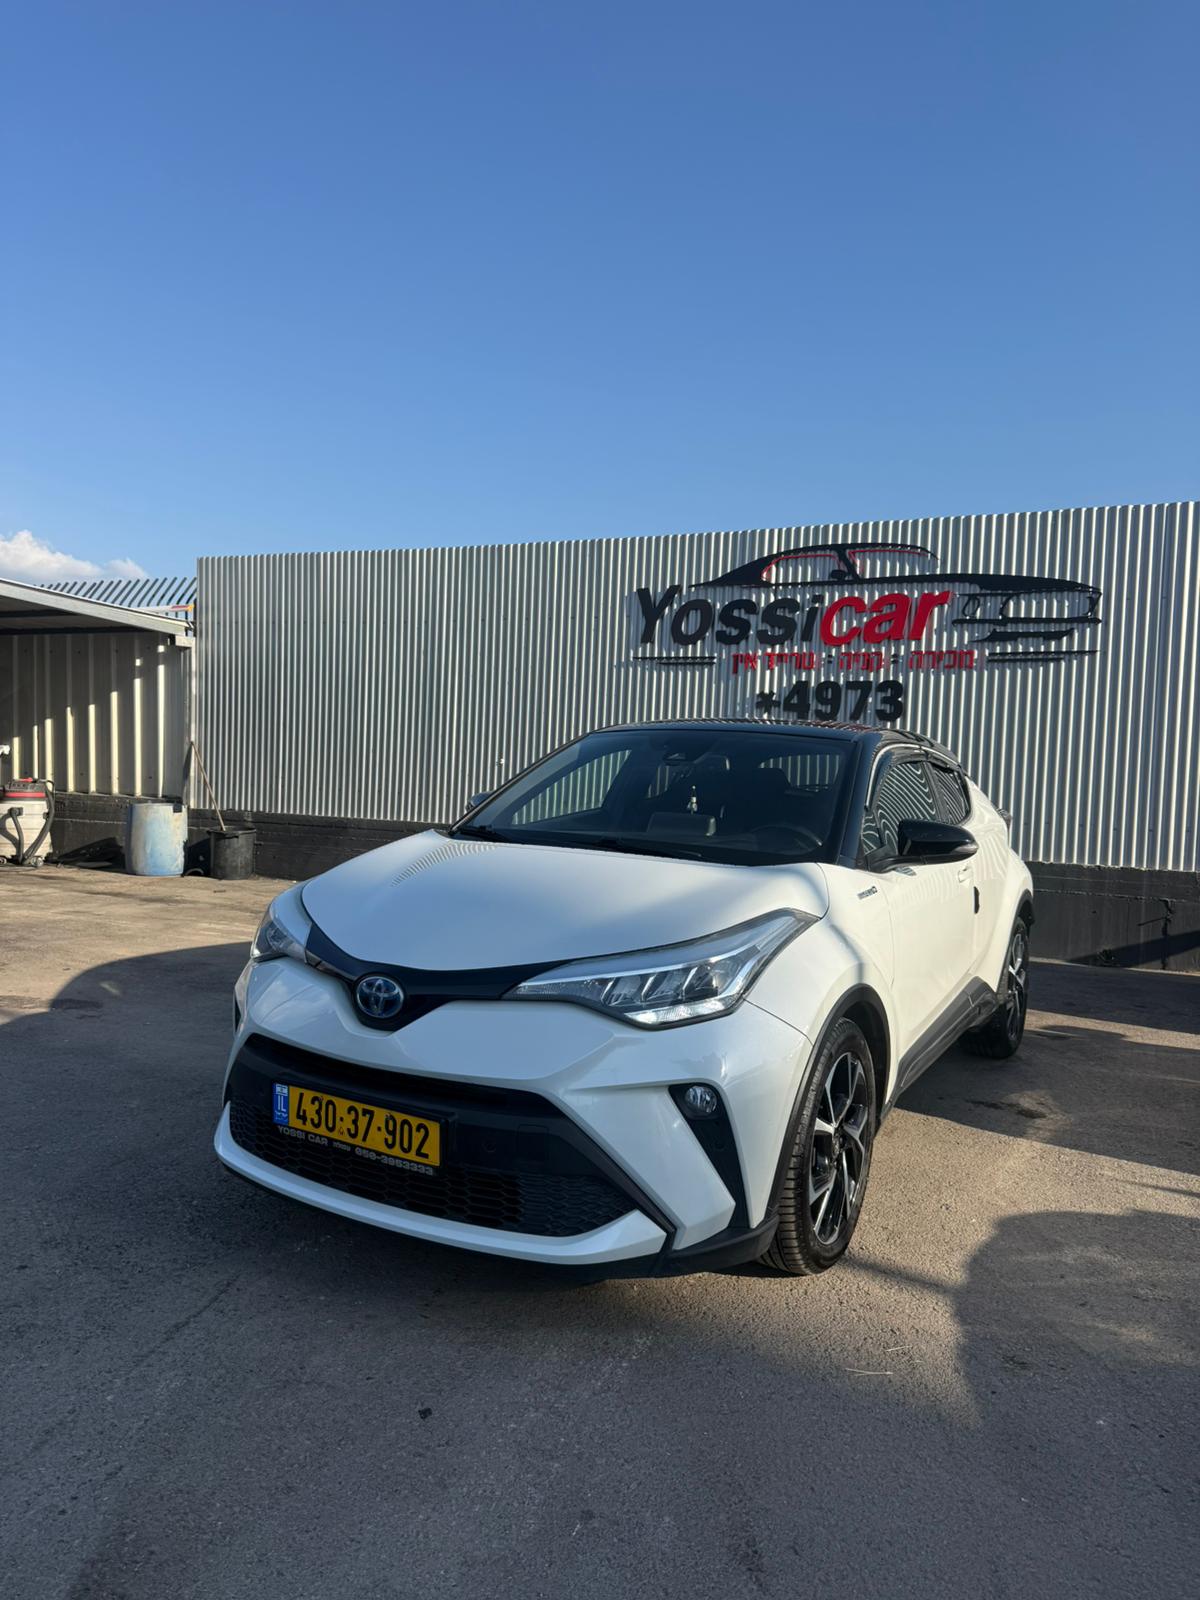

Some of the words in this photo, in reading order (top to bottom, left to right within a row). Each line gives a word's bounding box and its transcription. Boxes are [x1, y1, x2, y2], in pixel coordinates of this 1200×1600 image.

[839, 651, 882, 672] קניה
[909, 649, 974, 670] מכירה
[277, 1095, 286, 1112] IL
[278, 1125, 305, 1139] YOSSI
[307, 1133, 329, 1146] CAR
